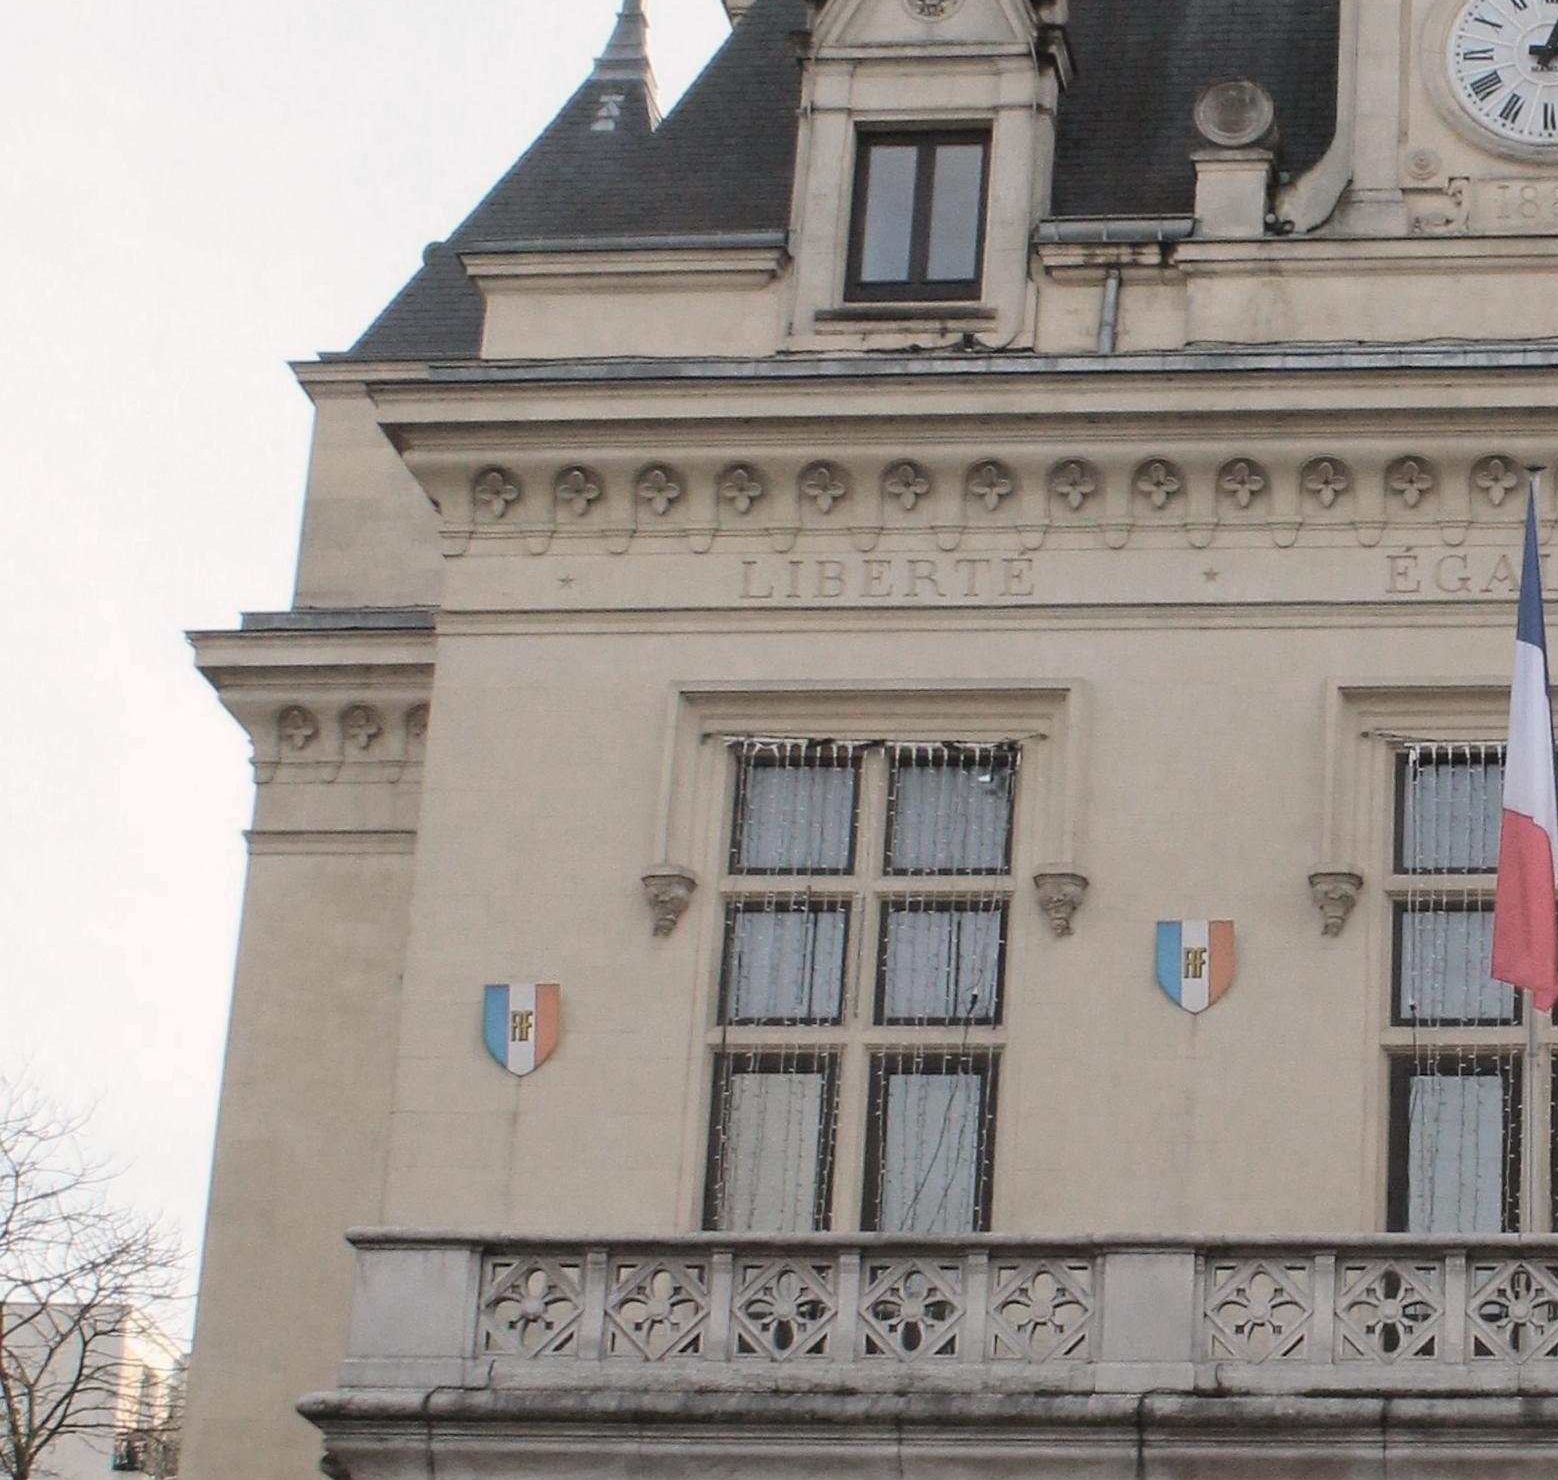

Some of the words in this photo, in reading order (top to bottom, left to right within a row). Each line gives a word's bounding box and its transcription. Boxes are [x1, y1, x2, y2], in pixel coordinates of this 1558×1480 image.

[739, 550, 1036, 599] LIBERTÉ
[1184, 947, 1208, 979] RF
[510, 1010, 533, 1042] RF
